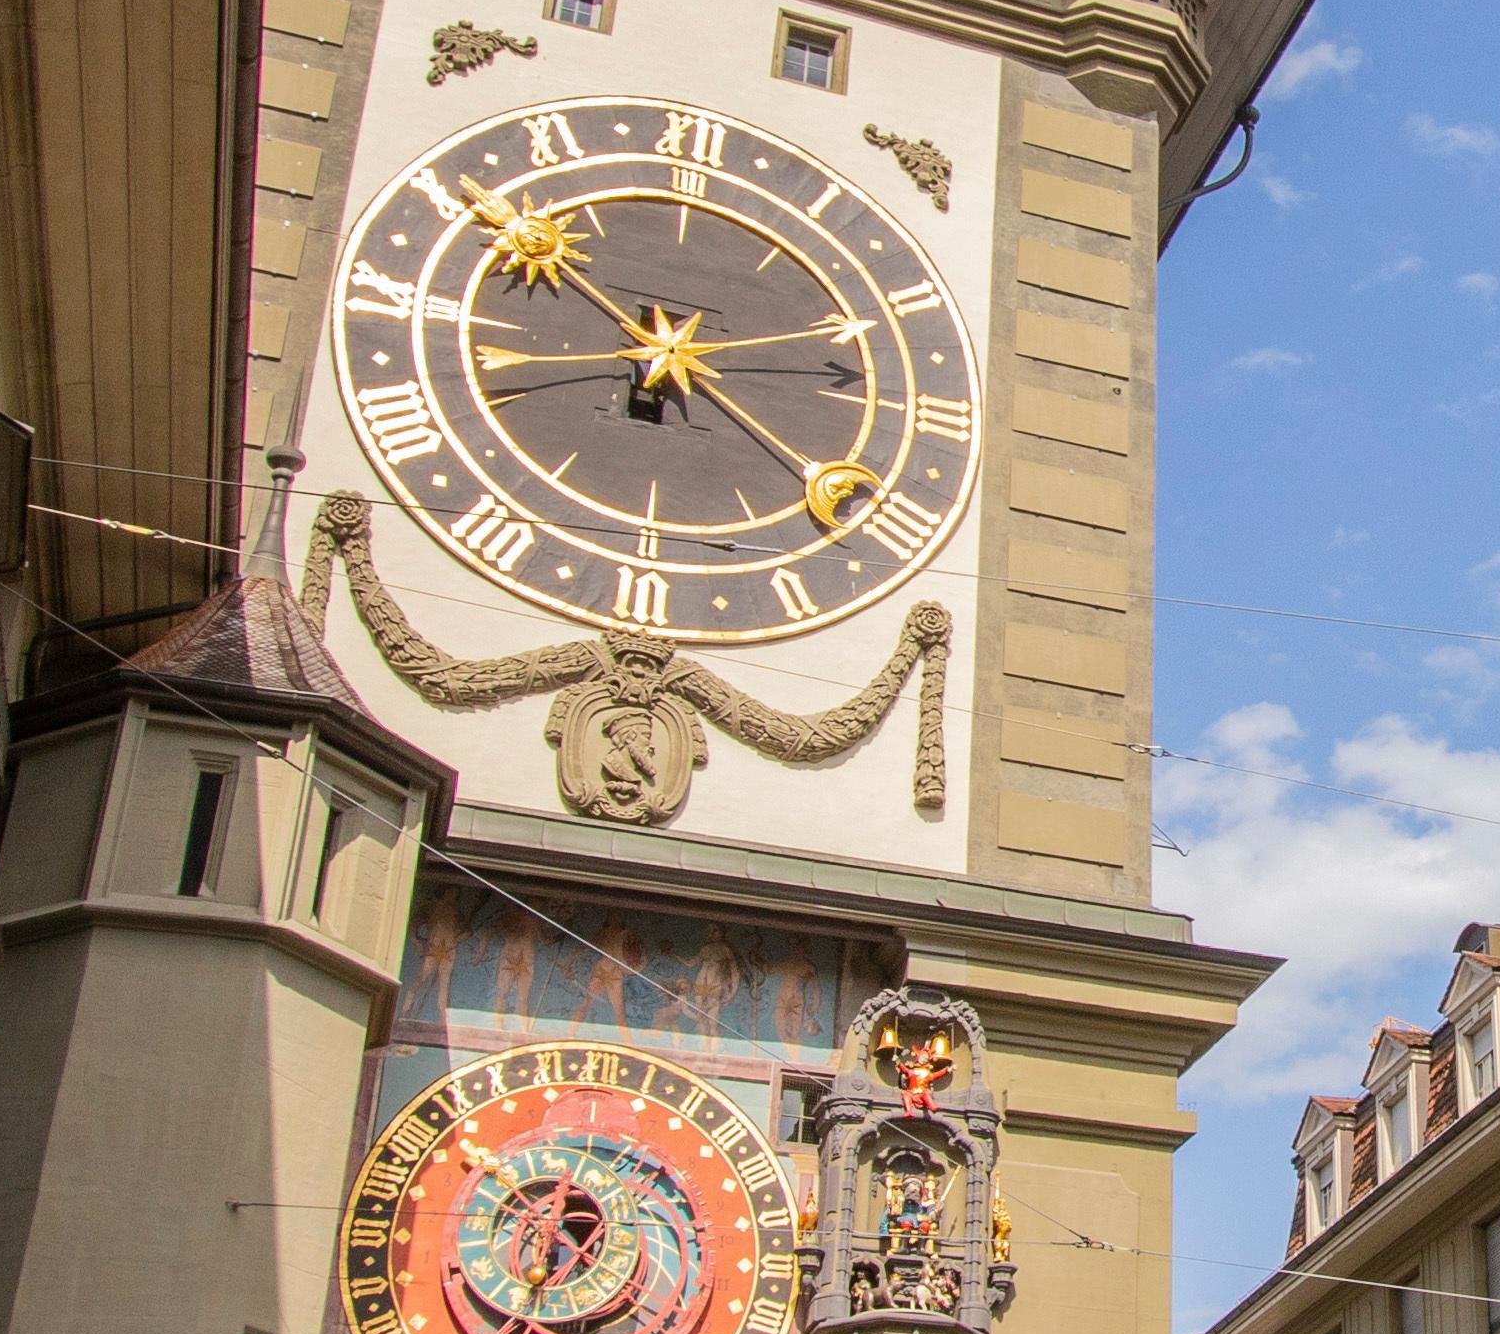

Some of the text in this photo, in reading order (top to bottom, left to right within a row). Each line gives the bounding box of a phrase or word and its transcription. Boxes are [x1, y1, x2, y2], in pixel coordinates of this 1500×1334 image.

[655, 110, 729, 169] XII
[886, 277, 943, 319] II
[914, 392, 974, 444] III
